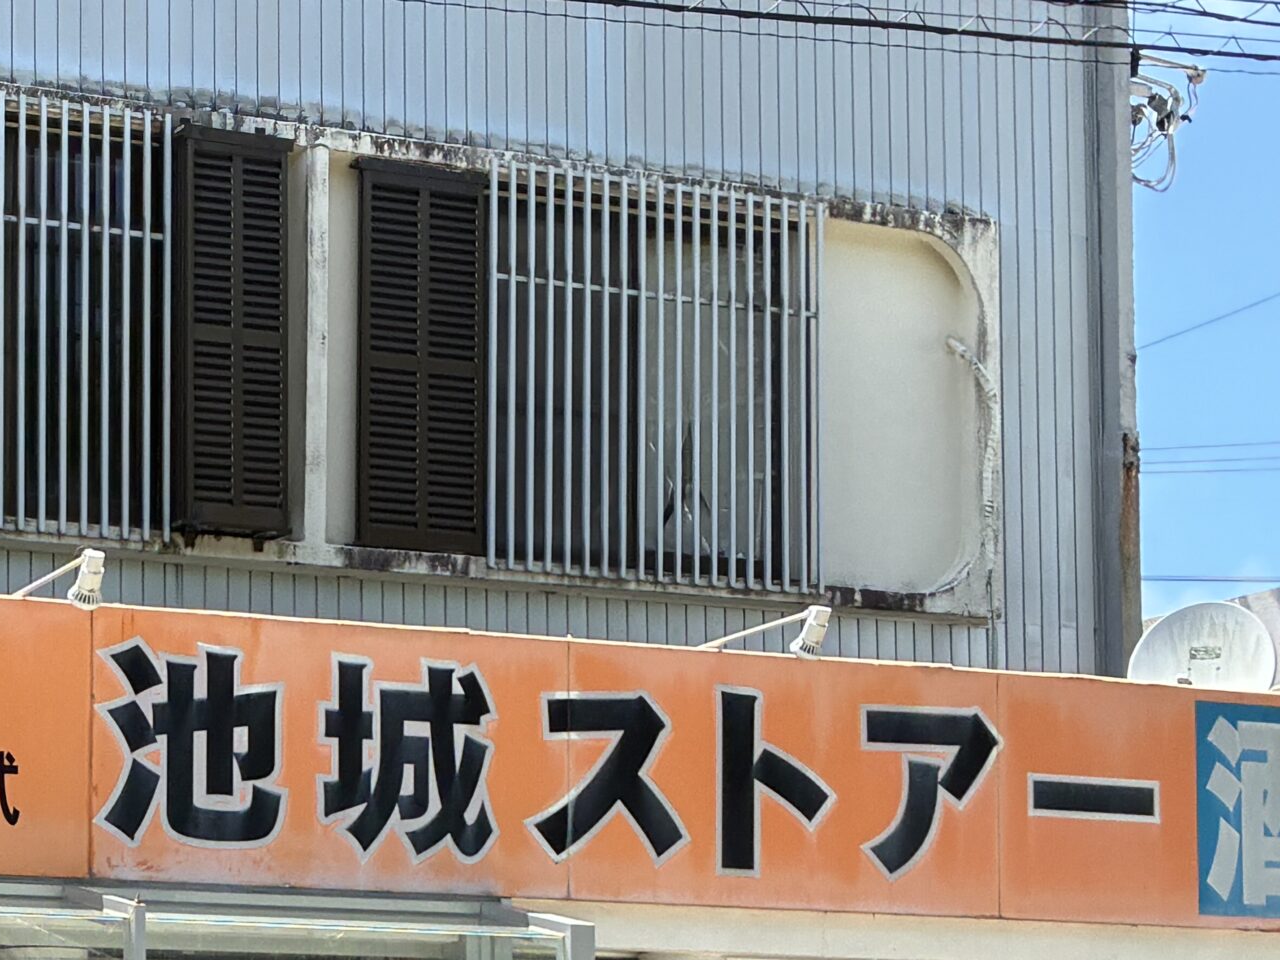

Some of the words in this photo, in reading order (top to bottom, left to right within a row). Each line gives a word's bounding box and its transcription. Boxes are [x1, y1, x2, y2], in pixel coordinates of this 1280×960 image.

[95, 635, 1160, 879] 池城ストアー
